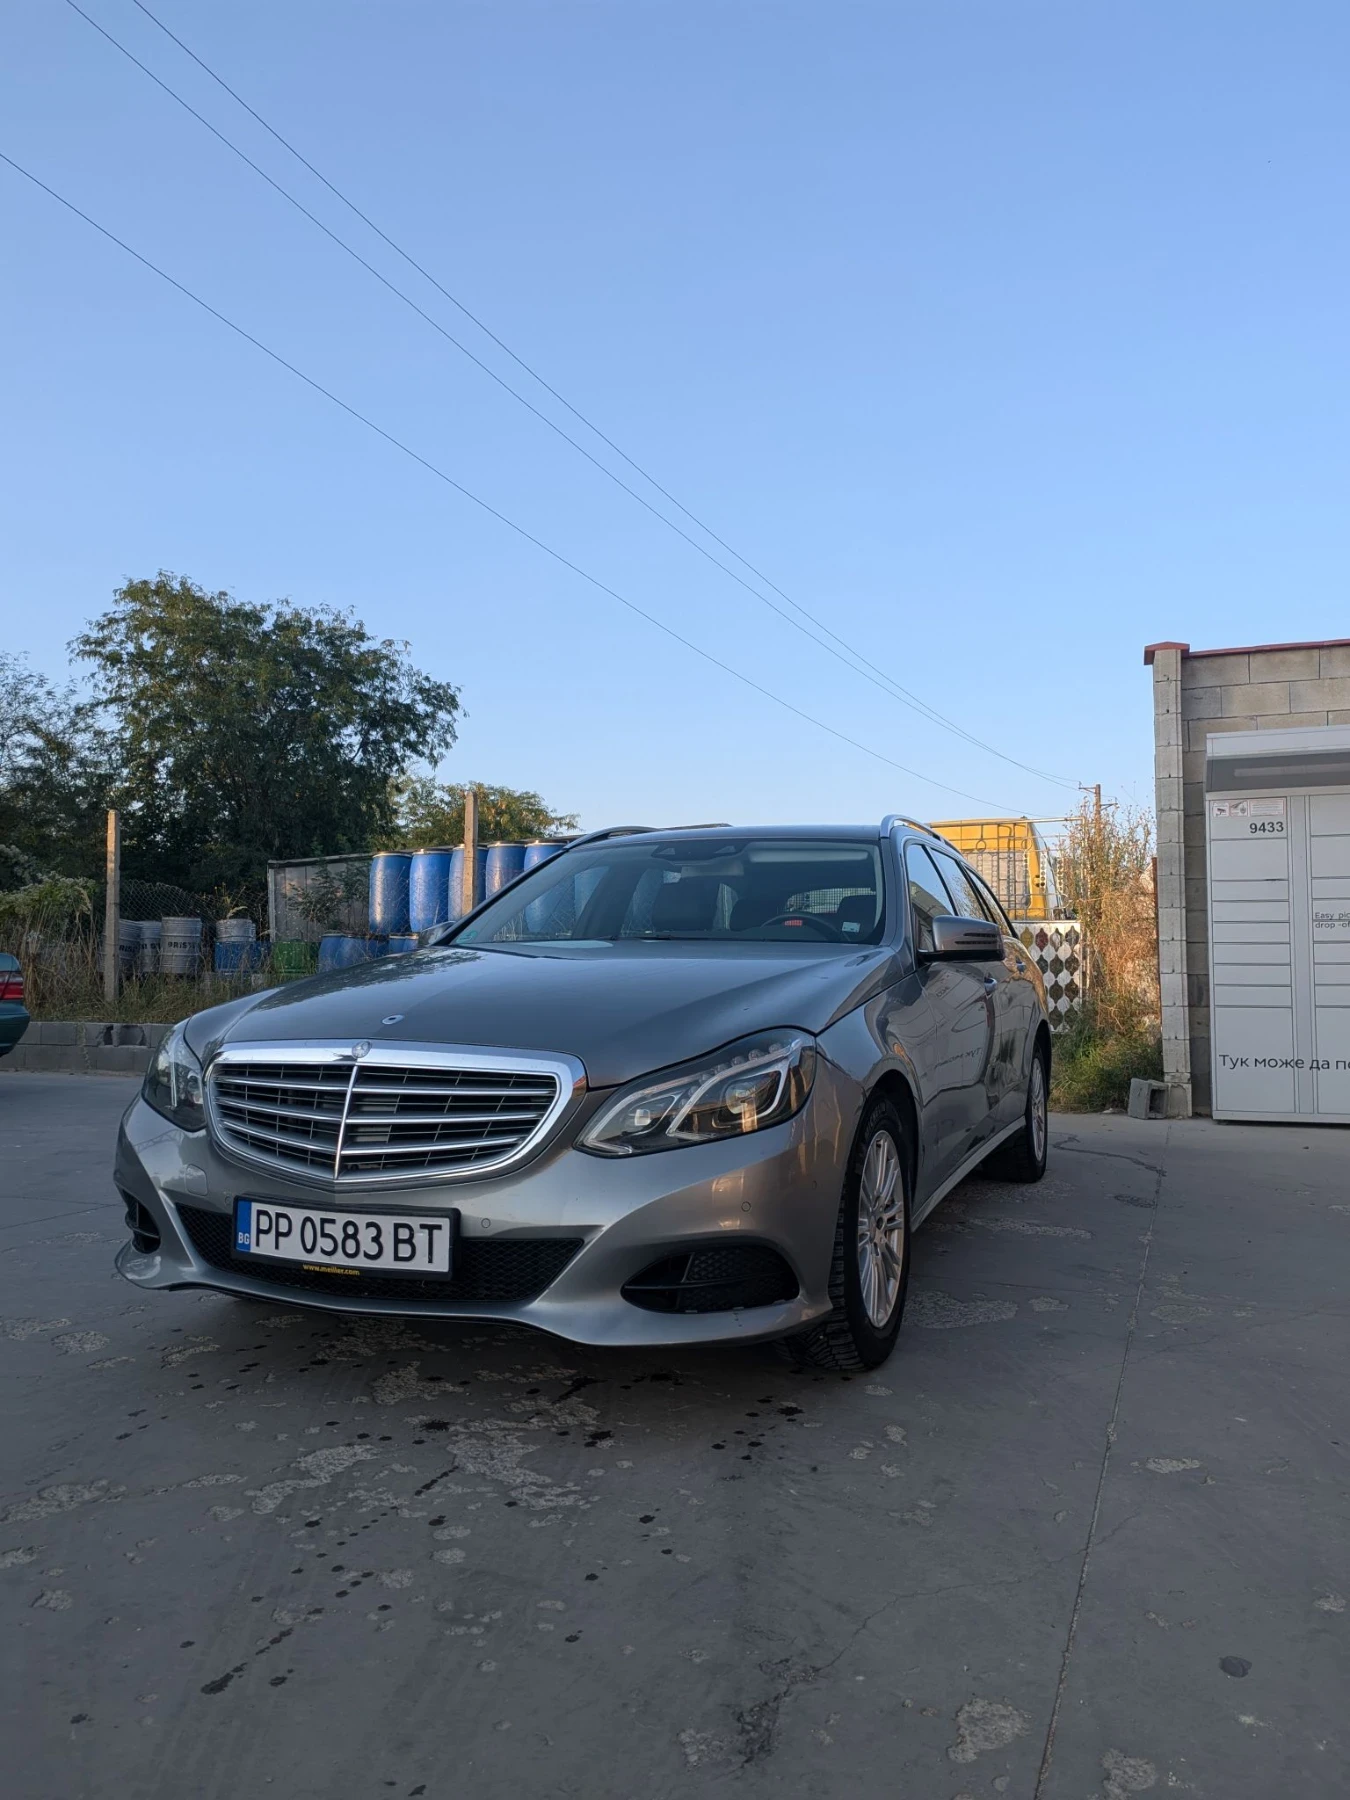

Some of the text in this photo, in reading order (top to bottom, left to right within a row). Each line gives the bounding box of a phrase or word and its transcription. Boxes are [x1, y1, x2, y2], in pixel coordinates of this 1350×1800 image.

[1249, 821, 1284, 834] 9433
[1314, 911, 1335, 920] Easy
[1314, 921, 1336, 930] drop
[1218, 1053, 1250, 1070] Тук
[1254, 1057, 1305, 1069] може
[1309, 1059, 1330, 1071] да
[238, 1231, 250, 1245] BG
[255, 1208, 442, 1264] PP 0583 BT
